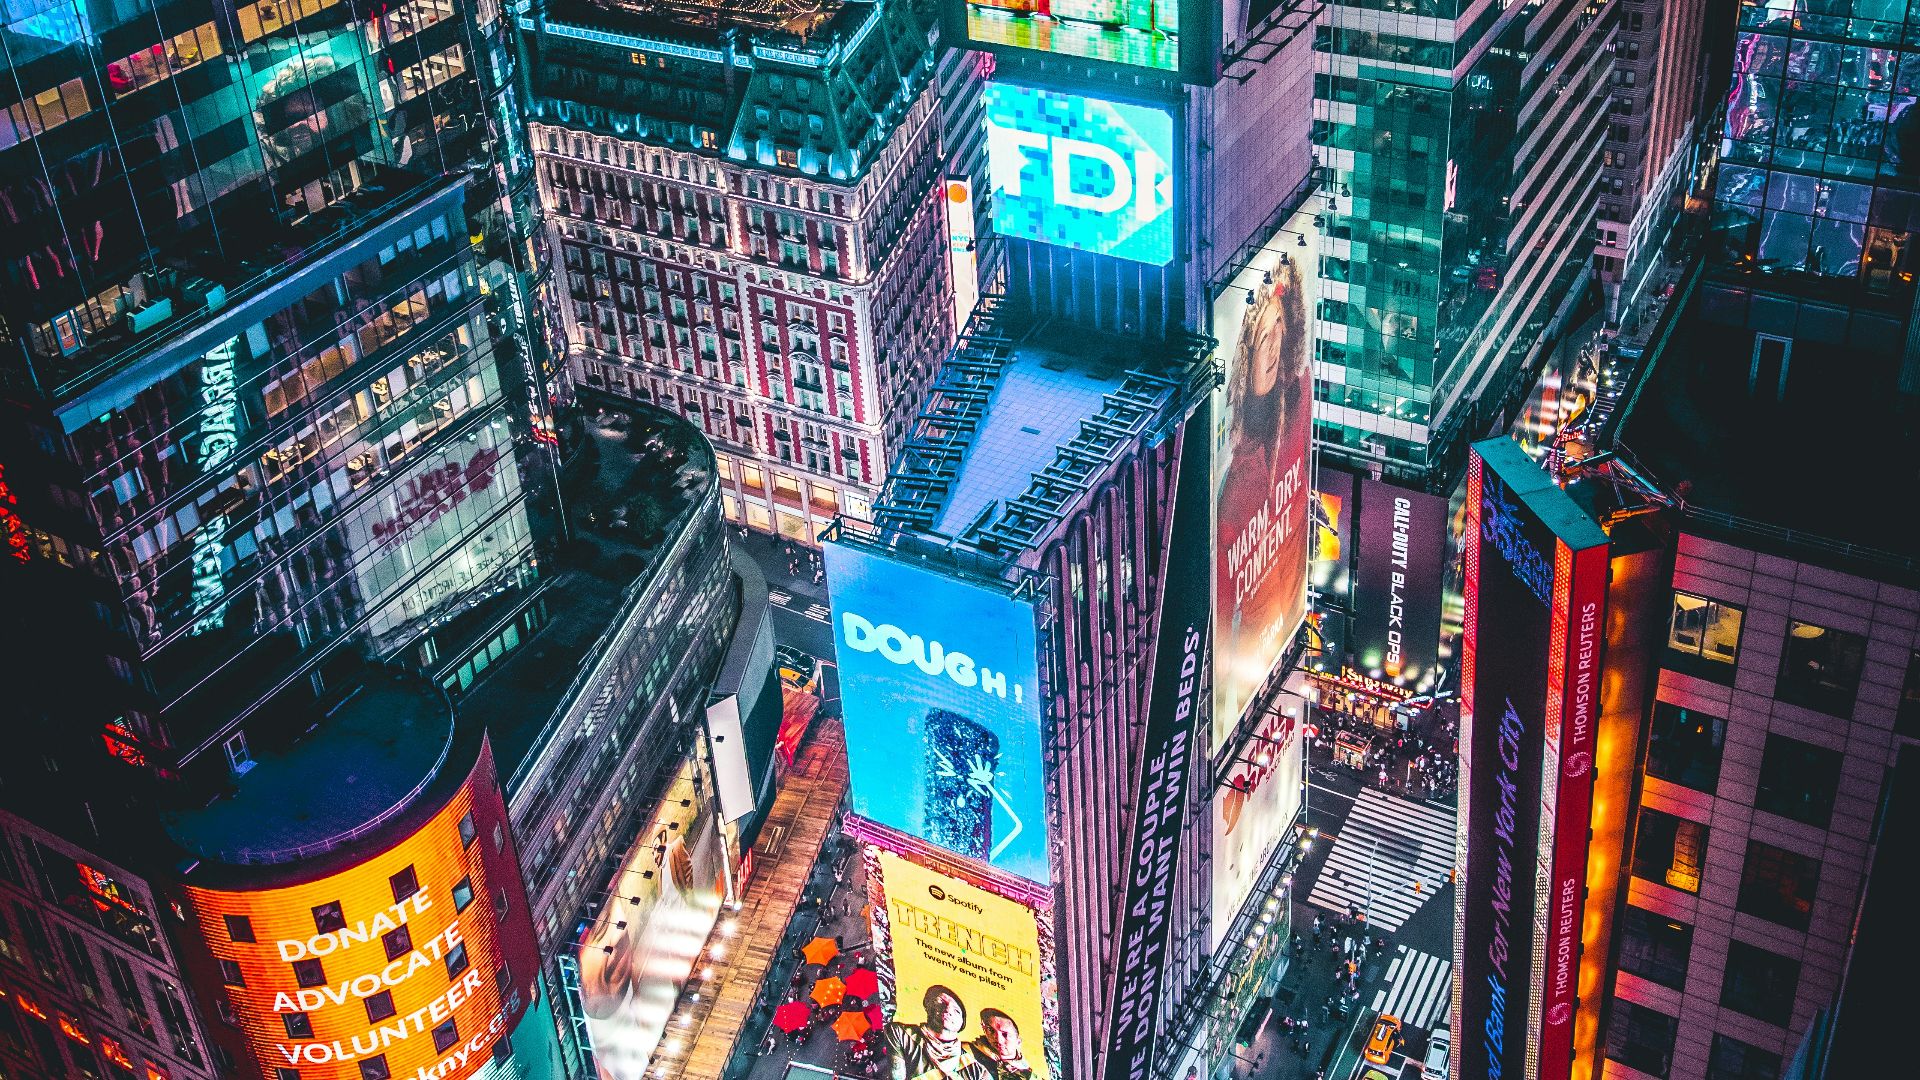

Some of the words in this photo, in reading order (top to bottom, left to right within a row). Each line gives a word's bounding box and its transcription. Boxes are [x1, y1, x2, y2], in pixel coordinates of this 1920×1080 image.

[1227, 499, 1271, 579] WARM.
[1275, 457, 1301, 516] DRY.
[1393, 497, 1411, 530] CALL
[1236, 504, 1292, 604] CONTENT.
[1391, 531, 1409, 570] DUTY
[1388, 572, 1405, 628] BLACK
[1386, 630, 1401, 664] OPS
[1578, 602, 1596, 673] REUTERS
[1498, 697, 1525, 771] City
[1573, 673, 1591, 745] THOMSON
[1494, 770, 1517, 847] York
[948, 894, 983, 914] Spotify
[1132, 891, 1149, 917] A
[1134, 942, 1160, 1045] DON'T
[1147, 836, 1173, 937] WANT
[1162, 730, 1187, 826] TWIN
[1491, 845, 1512, 927] New
[1559, 878, 1575, 935] REUTERS
[277, 885, 433, 962] DONATE
[892, 898, 1033, 977] TRENCH
[1489, 920, 1509, 981] For
[273, 920, 463, 1012] ADVOCATE
[915, 937, 933, 951] The
[934, 947, 955, 960] new
[957, 956, 987, 973] album
[988, 967, 1013, 984] from
[923, 951, 957, 971] twenty
[1555, 936, 1571, 997] THOMSON
[276, 969, 483, 1064] VOLUNTEER
[411, 991, 520, 1080] knyc.org
[1486, 973, 1506, 1055] Bank
